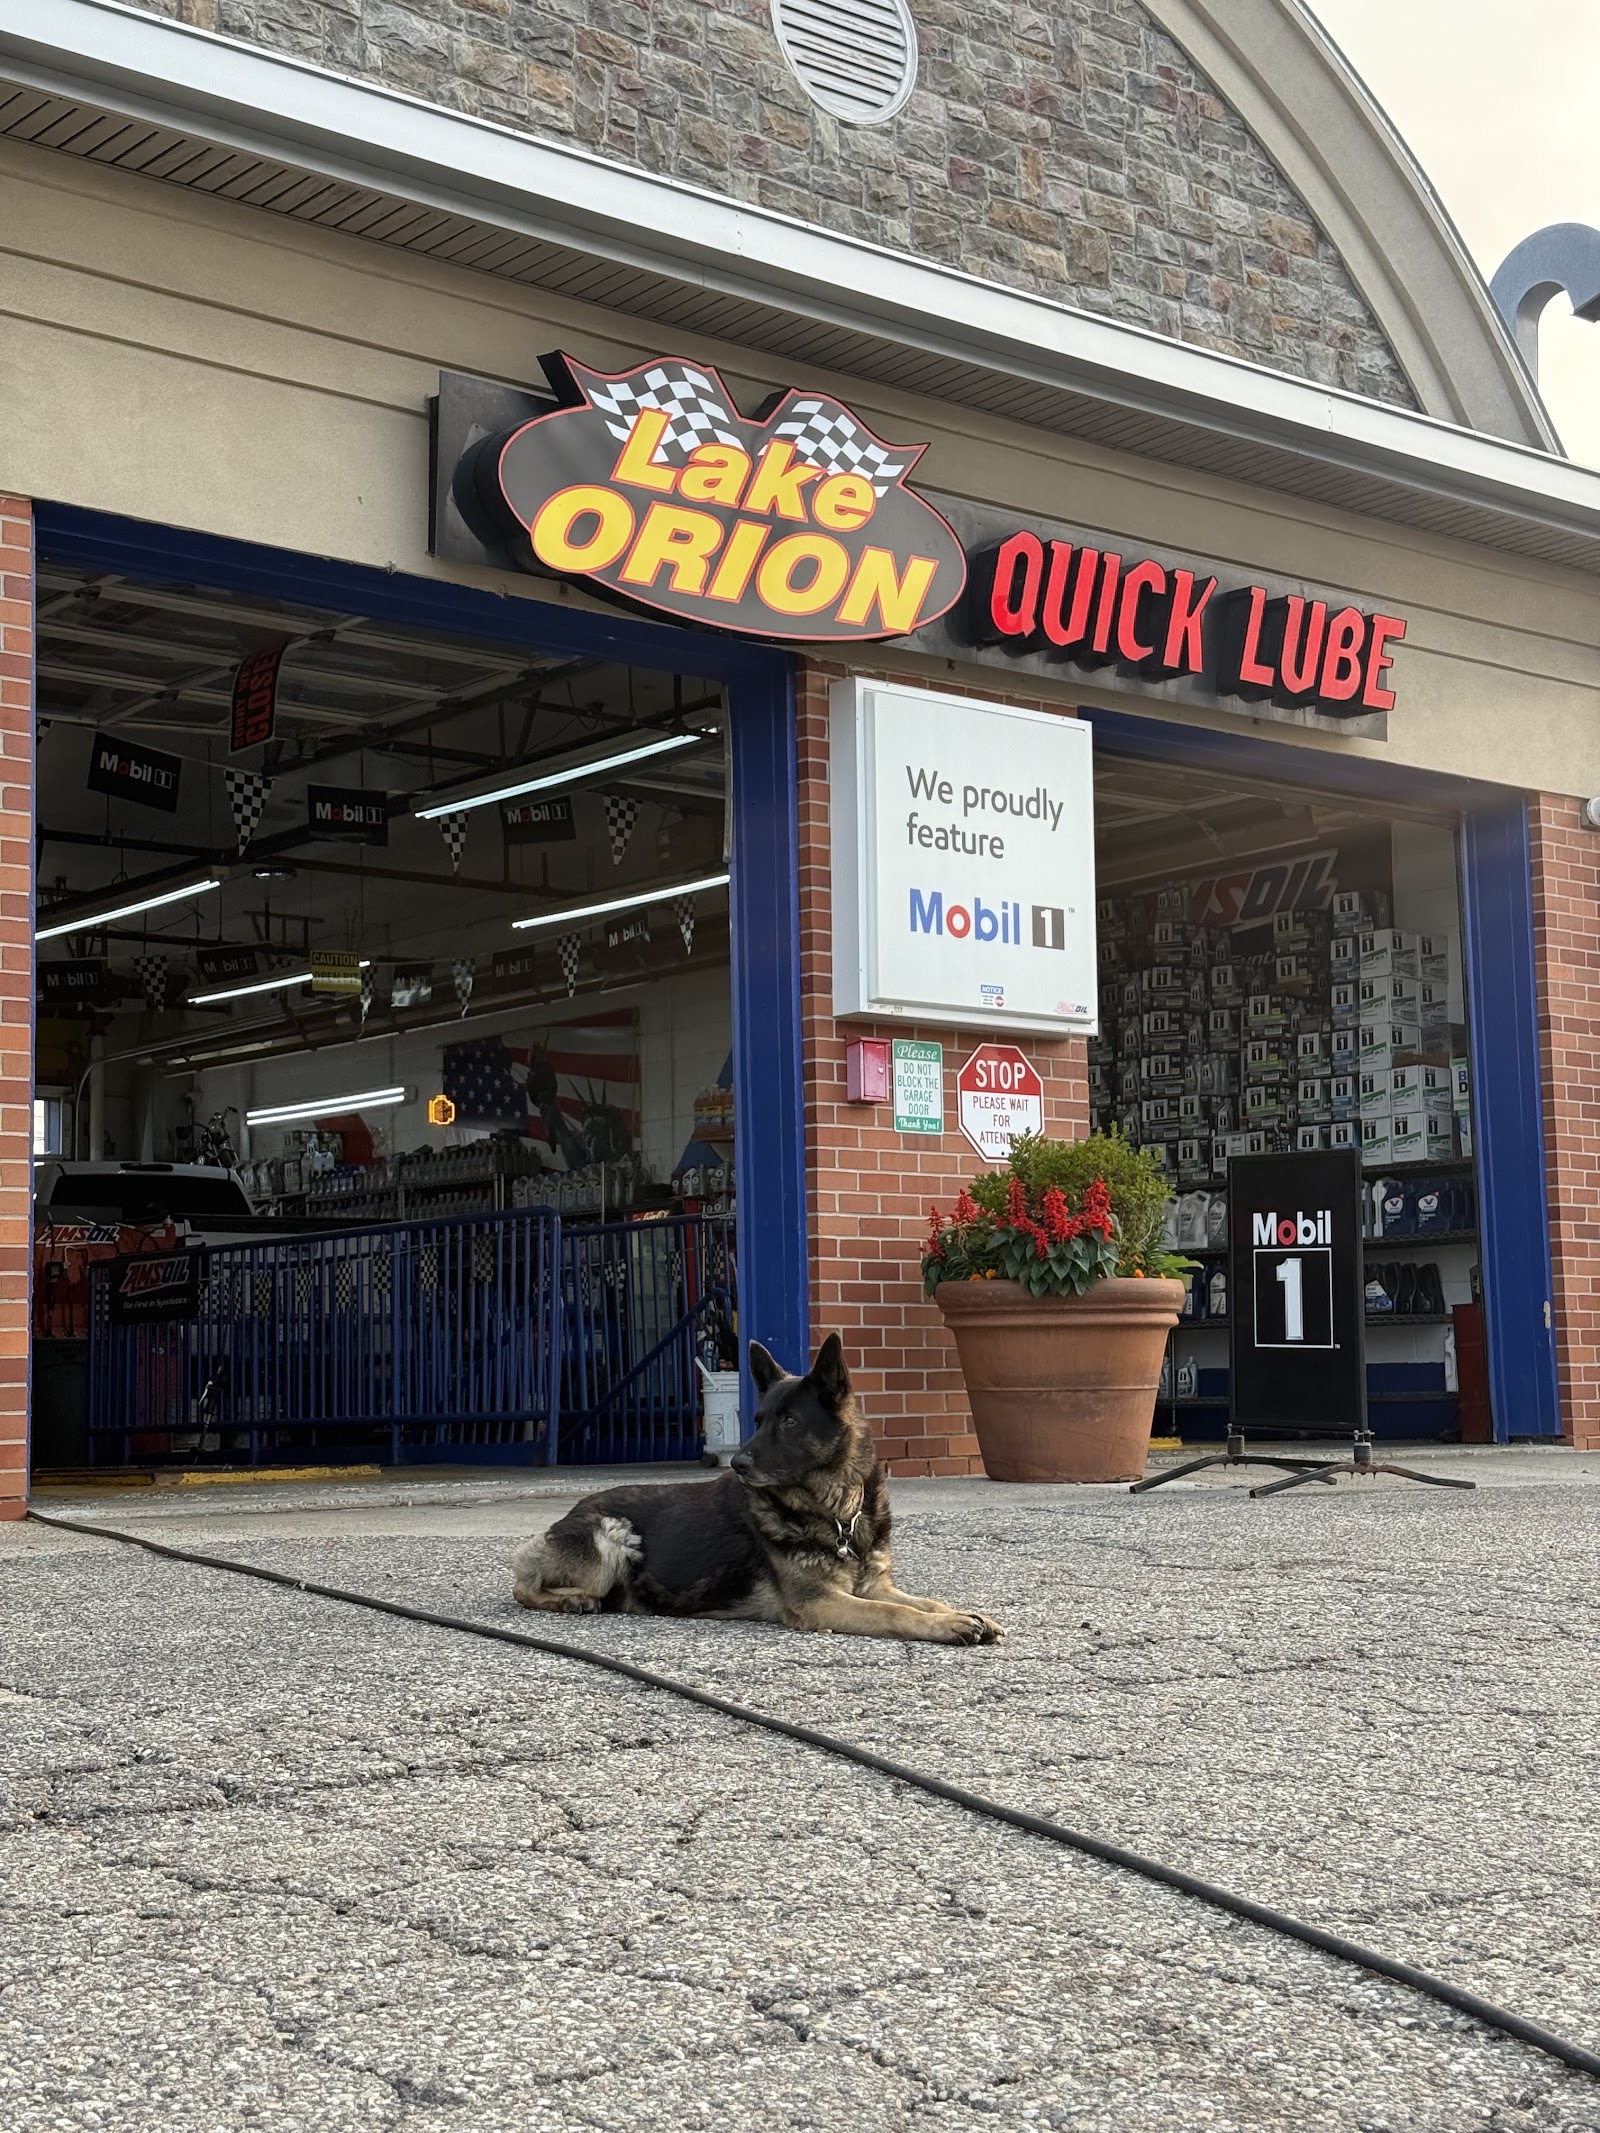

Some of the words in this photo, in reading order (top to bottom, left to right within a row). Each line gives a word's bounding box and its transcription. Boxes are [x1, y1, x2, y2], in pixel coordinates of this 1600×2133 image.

[611, 407, 877, 532] Lake
[531, 484, 940, 633] ORION
[990, 530, 1219, 673] QUICK
[1240, 585, 1407, 711] LUBE
[99, 750, 153, 784] Mobil
[905, 765, 954, 805] We
[963, 785, 1064, 832] proudly
[315, 801, 364, 823] Mobil
[506, 804, 551, 825] Mobil
[906, 812, 1005, 859] feature
[909, 887, 1021, 946] Mobil
[608, 923, 635, 948] Mobil
[203, 958, 239, 974] Mbil
[312, 952, 358, 967] CAUTION
[495, 960, 521, 978] Mbil
[46, 972, 84, 987] Mbil
[981, 985, 1003, 995] NOTICE
[897, 1043, 938, 1061] Please
[903, 1062, 915, 1075] DO
[917, 1063, 932, 1076] NOT
[974, 1059, 1026, 1090] STOP
[897, 1075, 923, 1088] BLOCK
[925, 1077, 939, 1089] THE
[903, 1089, 934, 1102] GARAGE
[972, 1095, 1006, 1111] PLEASE
[1009, 1098, 1029, 1112] WAIT
[908, 1103, 930, 1116] DOOR
[993, 1113, 1011, 1127] FOR
[898, 1117, 921, 1129] Thank
[922, 1119, 940, 1131] You!
[1252, 1210, 1332, 1247] Mobil
[120, 1256, 190, 1296] AMSOIL
[1275, 1257, 1304, 1341] 1
